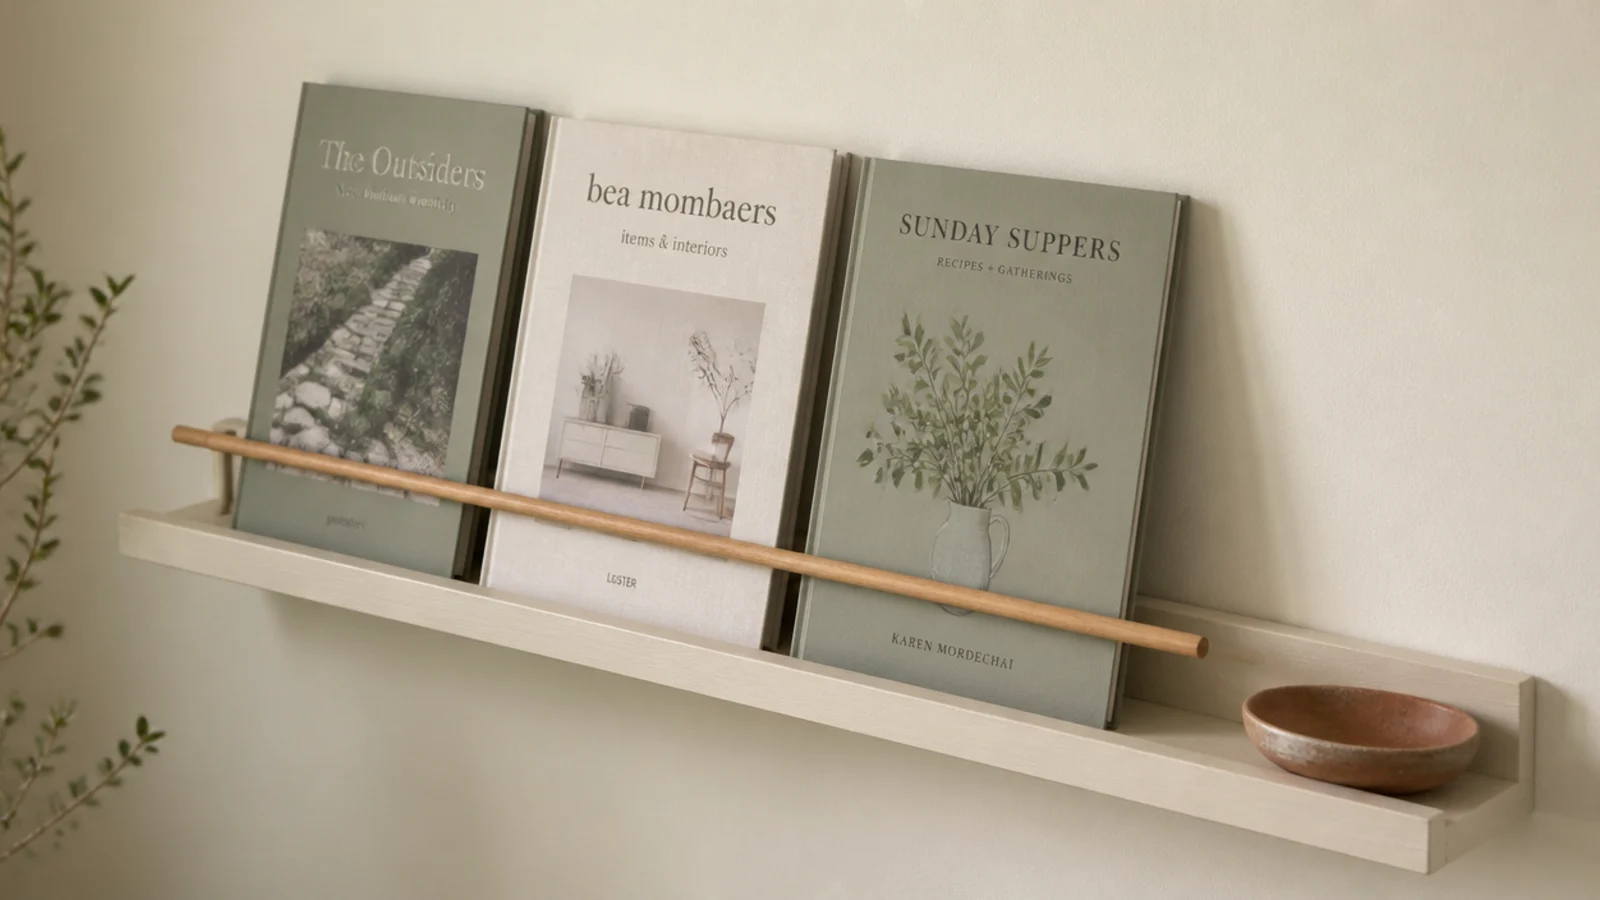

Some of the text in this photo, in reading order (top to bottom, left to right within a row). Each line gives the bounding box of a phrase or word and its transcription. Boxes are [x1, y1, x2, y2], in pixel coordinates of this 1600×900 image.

[319, 139, 487, 191] The Outsiders
[586, 172, 777, 226] bea mombaers
[621, 229, 728, 258] items & interiors
[899, 213, 1121, 262] SUNDAY SUPPERS
[936, 257, 984, 272] RECIPES
[998, 265, 1073, 284] GATHERINGS
[891, 633, 1014, 670] KAREN MORDECHAI
